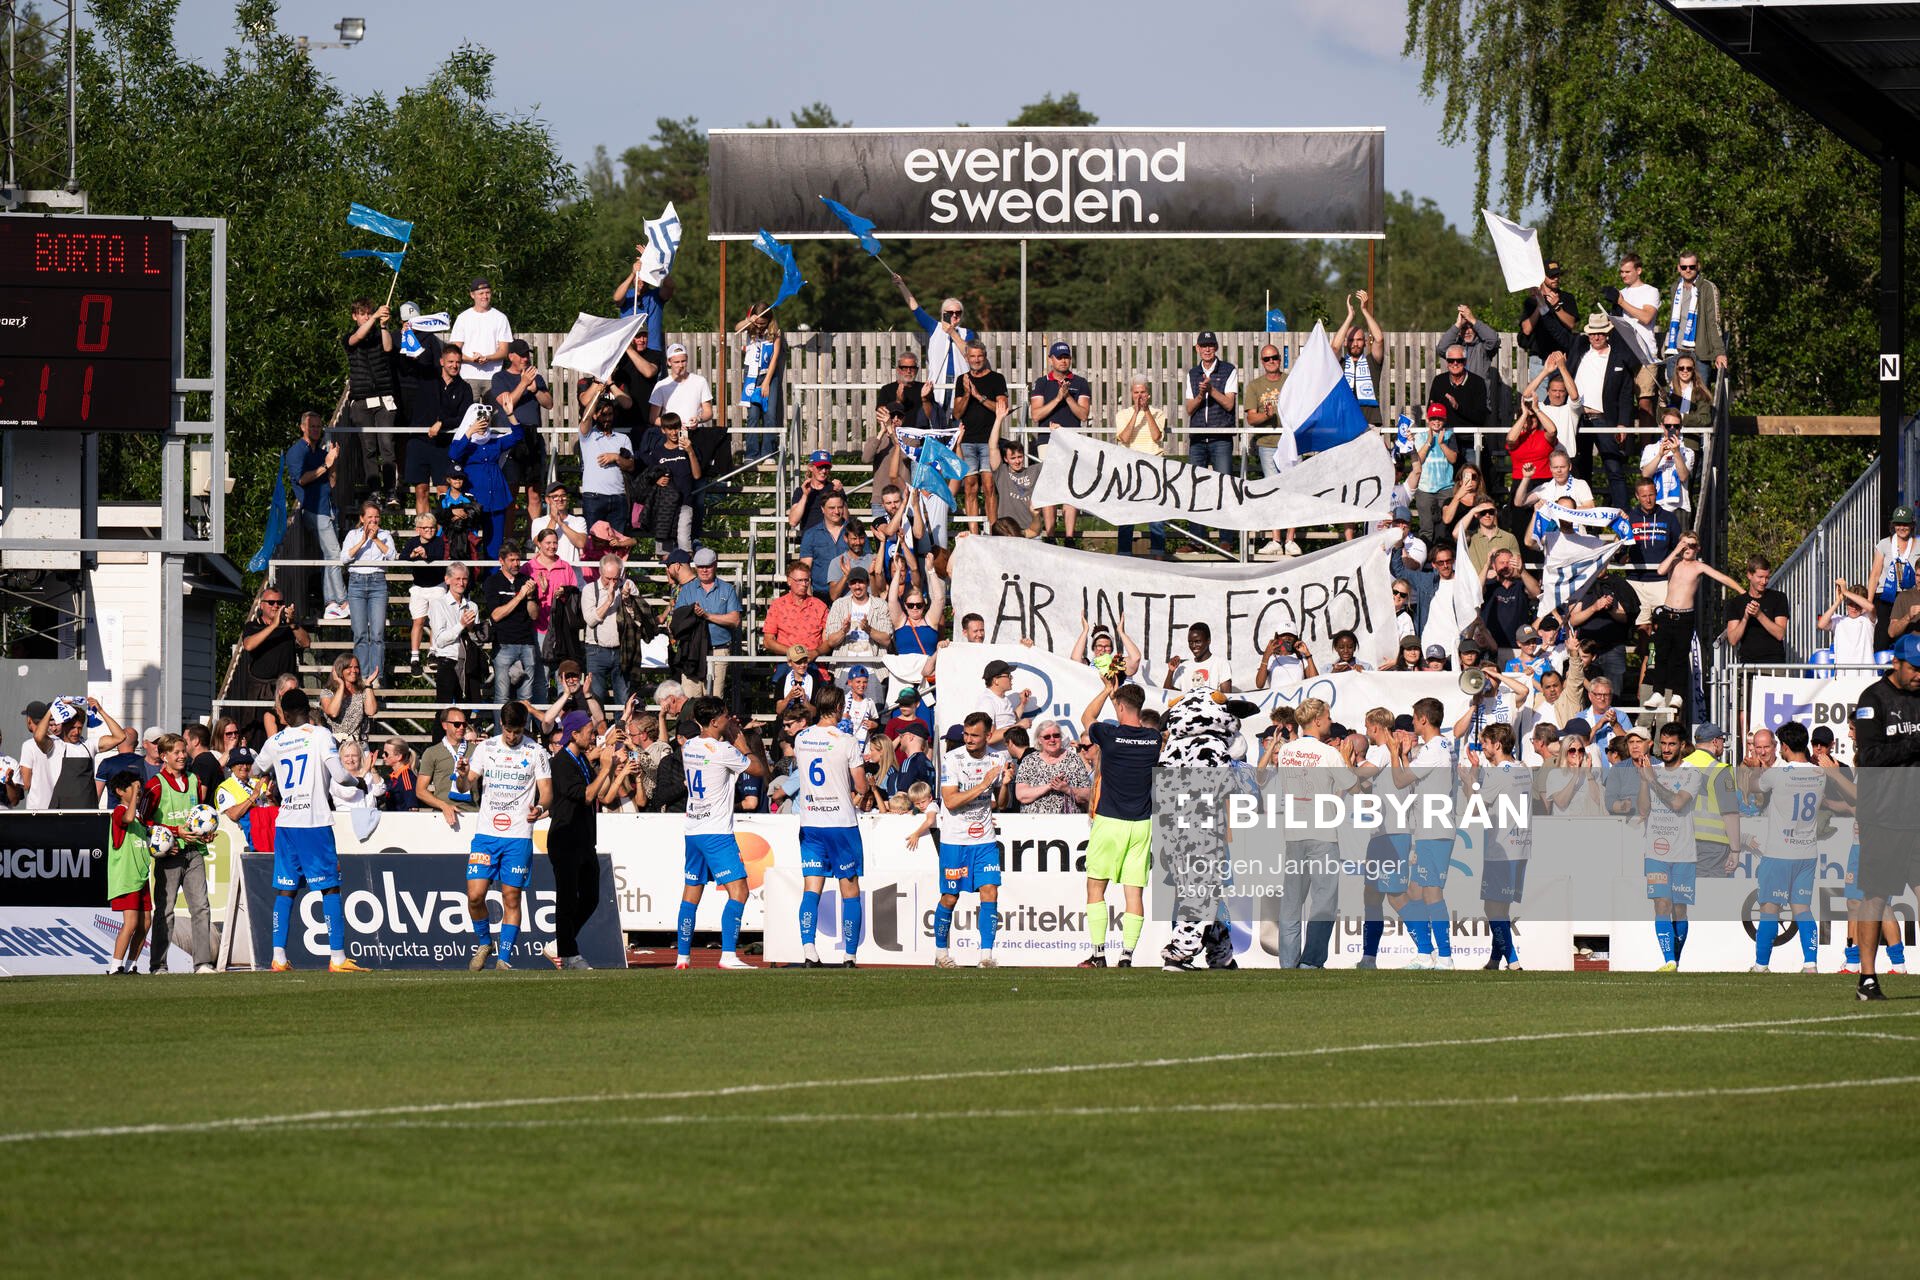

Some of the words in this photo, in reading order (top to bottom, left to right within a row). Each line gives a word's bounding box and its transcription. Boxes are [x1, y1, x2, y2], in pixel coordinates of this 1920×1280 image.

[904, 141, 1186, 183] everbrand
[929, 188, 1160, 224] sweden.
[36, 233, 125, 273] BORTA
[77, 294, 112, 352] 0
[1881, 357, 1897, 377] N
[990, 572, 1055, 654] ÄR
[1082, 586, 1196, 664] INTE
[1226, 566, 1373, 664] FÖRBI
[1115, 738, 1158, 746] ZINKTEKNIK
[280, 753, 308, 790] 27
[686, 769, 706, 799] 14
[808, 757, 826, 787] 6
[1791, 792, 1817, 822] 18
[0, 848, 90, 879] IGUM
[468, 865, 478, 874] 24
[947, 881, 957, 889] 10
[350, 941, 430, 960] Omtyckta
[433, 941, 466, 960] golv
[1002, 938, 1025, 949] zinc
[1029, 938, 1076, 953] diecasting
[1393, 943, 1415, 954] zinc
